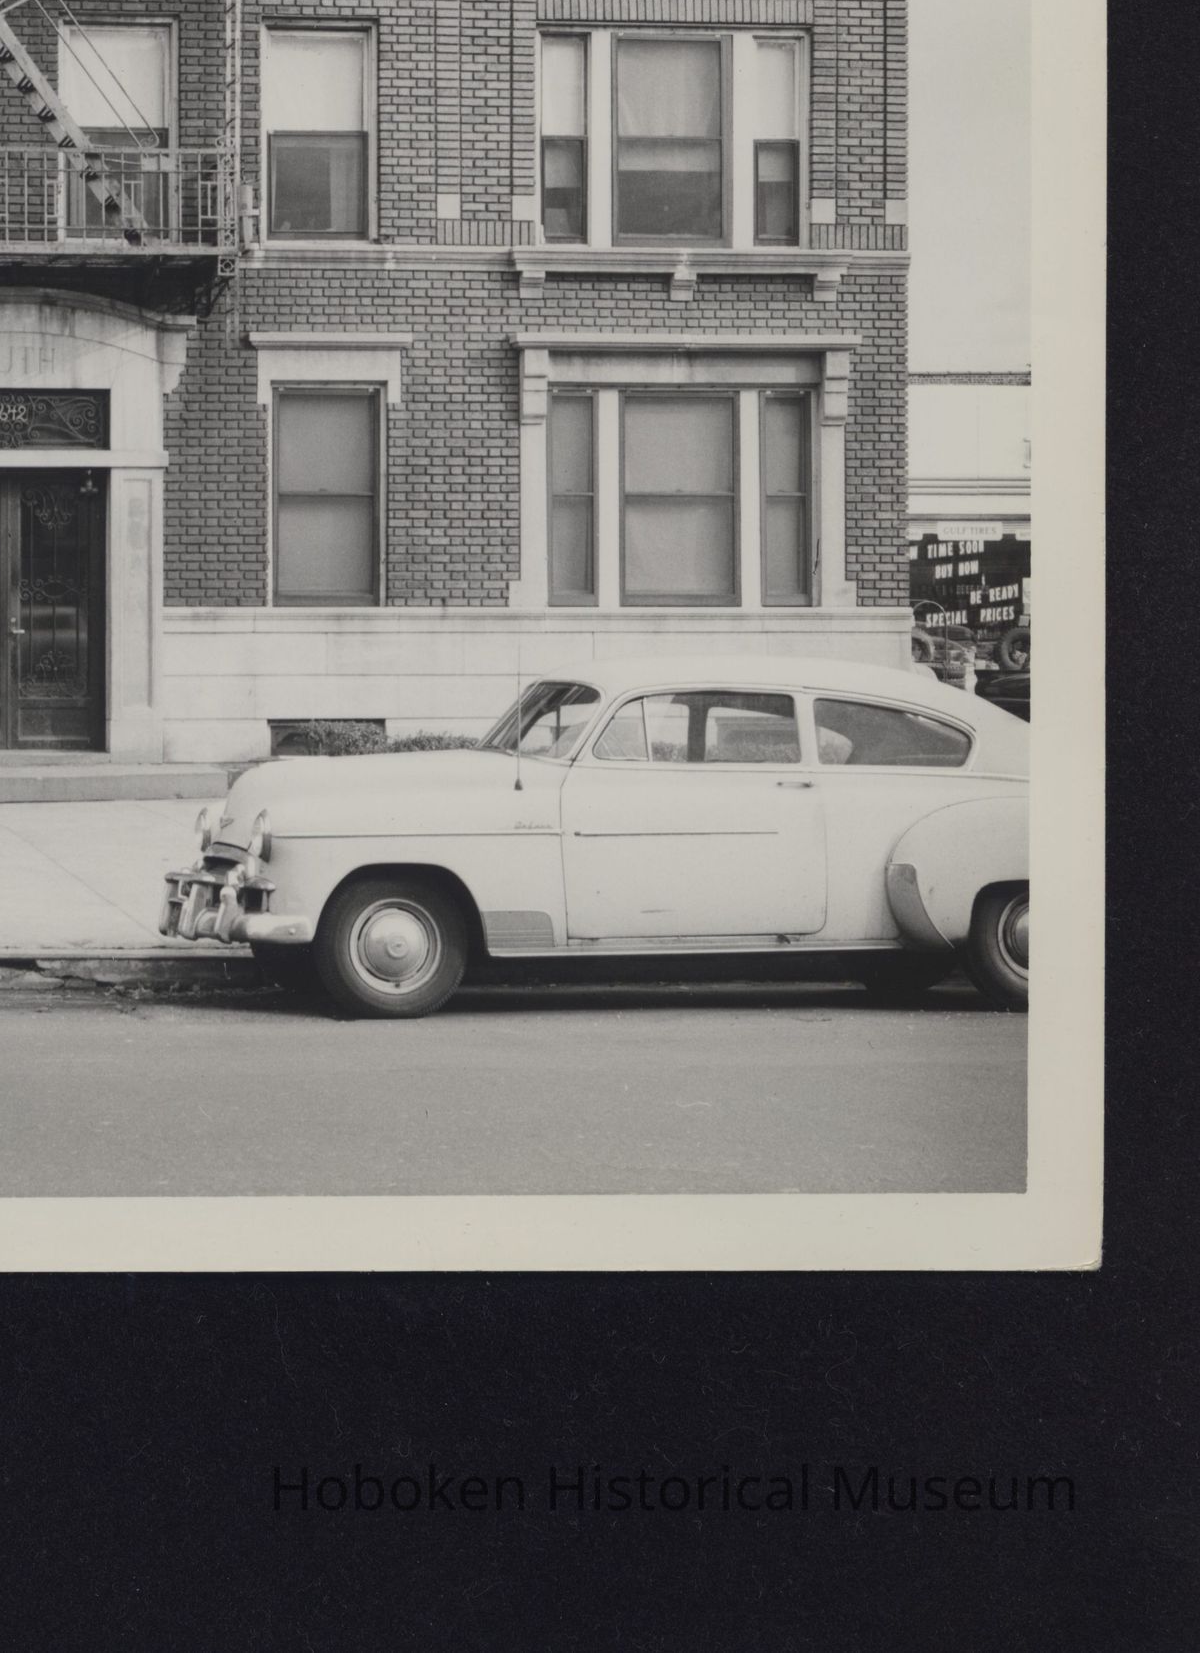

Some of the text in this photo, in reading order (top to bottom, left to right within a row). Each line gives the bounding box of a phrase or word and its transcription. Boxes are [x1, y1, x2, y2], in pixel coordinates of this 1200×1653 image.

[927, 542, 953, 559] TIME
[958, 540, 985, 556] SOON
[935, 560, 979, 579] BUY NOW
[970, 590, 982, 605] BE
[989, 583, 1019, 603] READY
[926, 606, 1015, 628] SPECIAL PRICES
